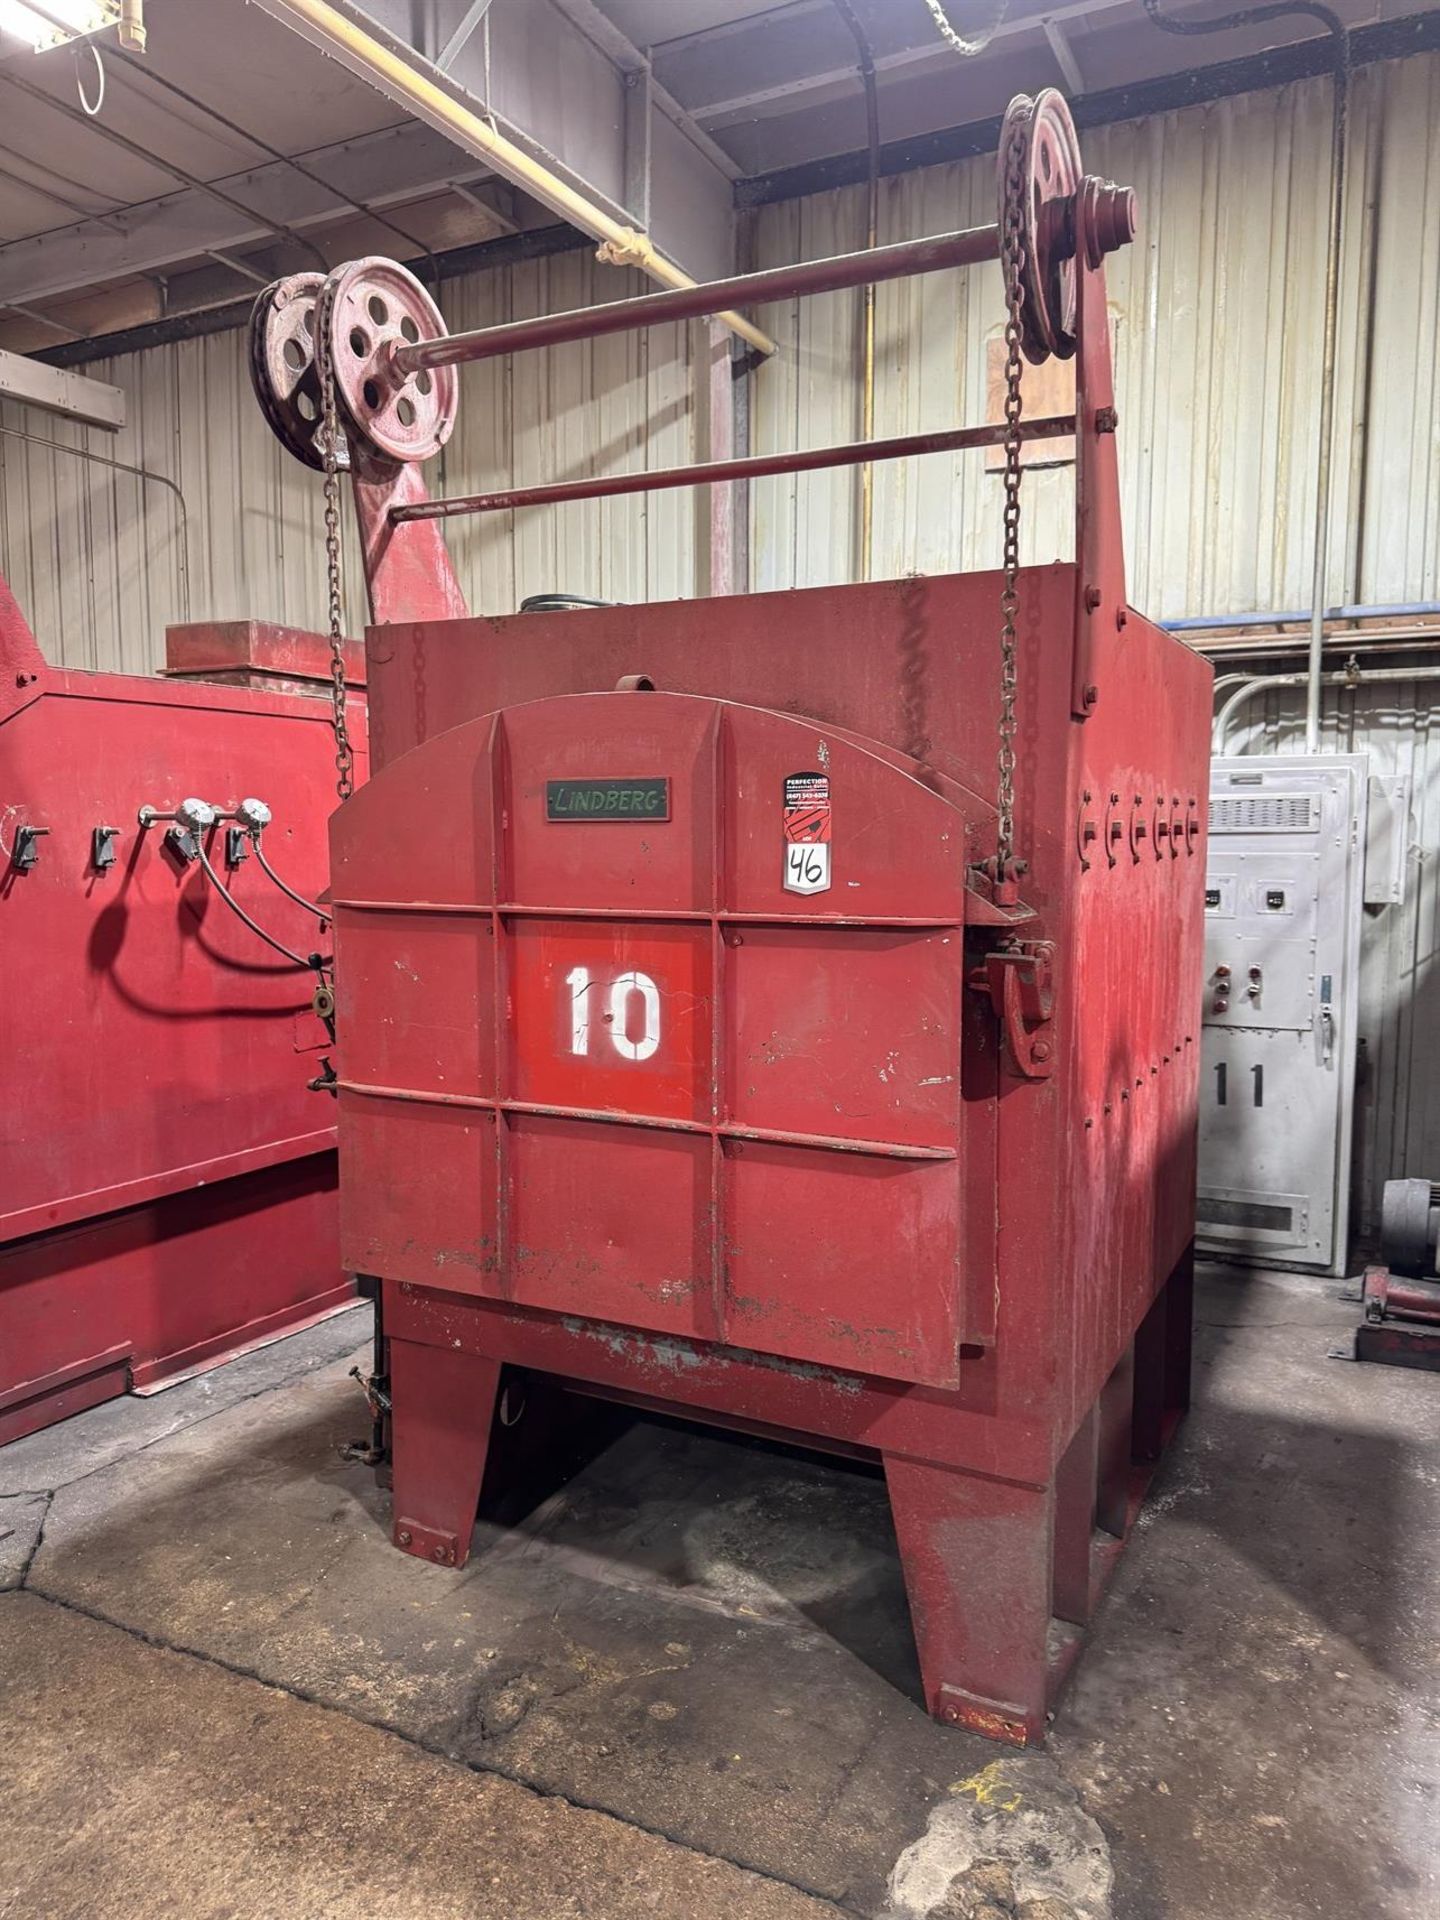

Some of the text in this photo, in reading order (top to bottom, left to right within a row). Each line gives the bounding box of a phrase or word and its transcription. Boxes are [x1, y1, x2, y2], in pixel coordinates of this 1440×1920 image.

[555, 788, 659, 811] LINDBERG
[790, 848, 822, 883] 46
[566, 967, 660, 1060] 10
[1214, 1062, 1263, 1107] 11
